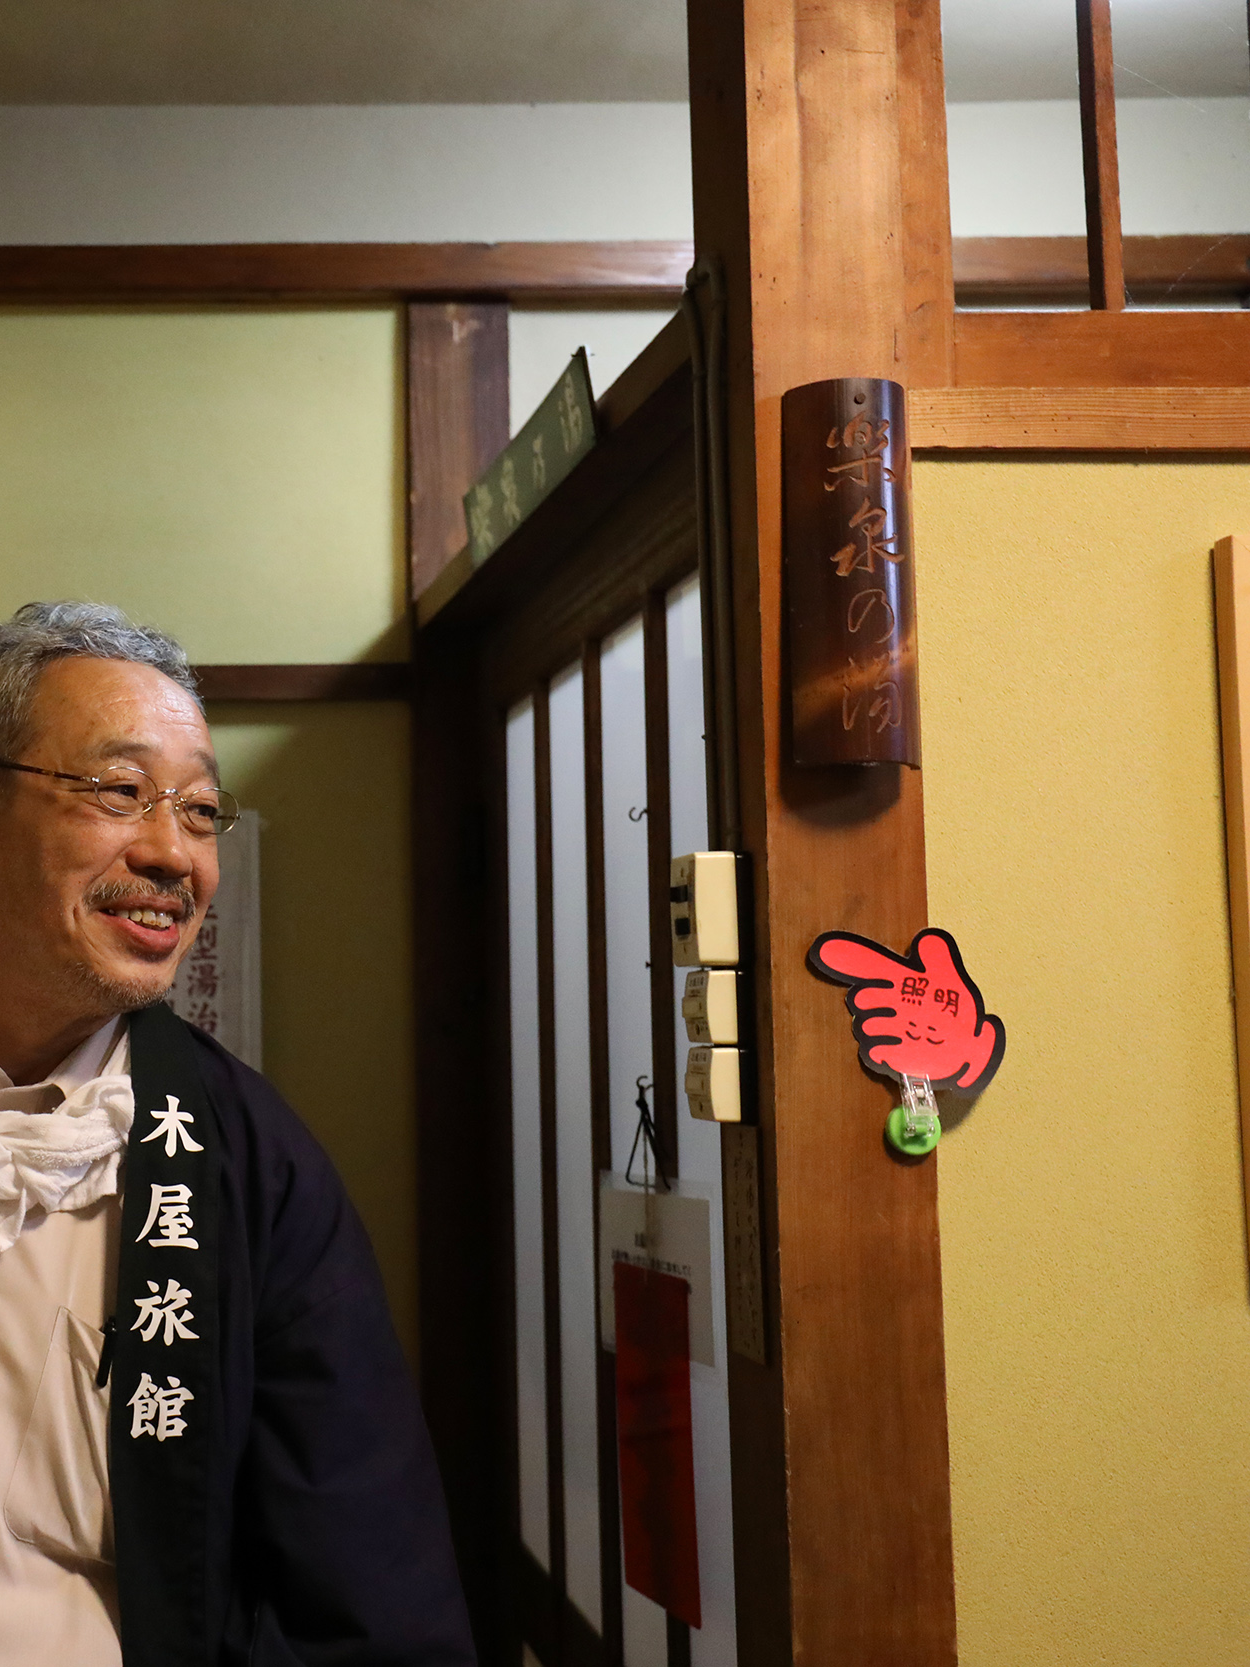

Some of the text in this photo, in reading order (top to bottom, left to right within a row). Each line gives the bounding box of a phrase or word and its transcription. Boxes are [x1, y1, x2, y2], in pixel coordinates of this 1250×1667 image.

[901, 976, 960, 1017] 照明
[126, 1095, 204, 1442] 木屋旅館
